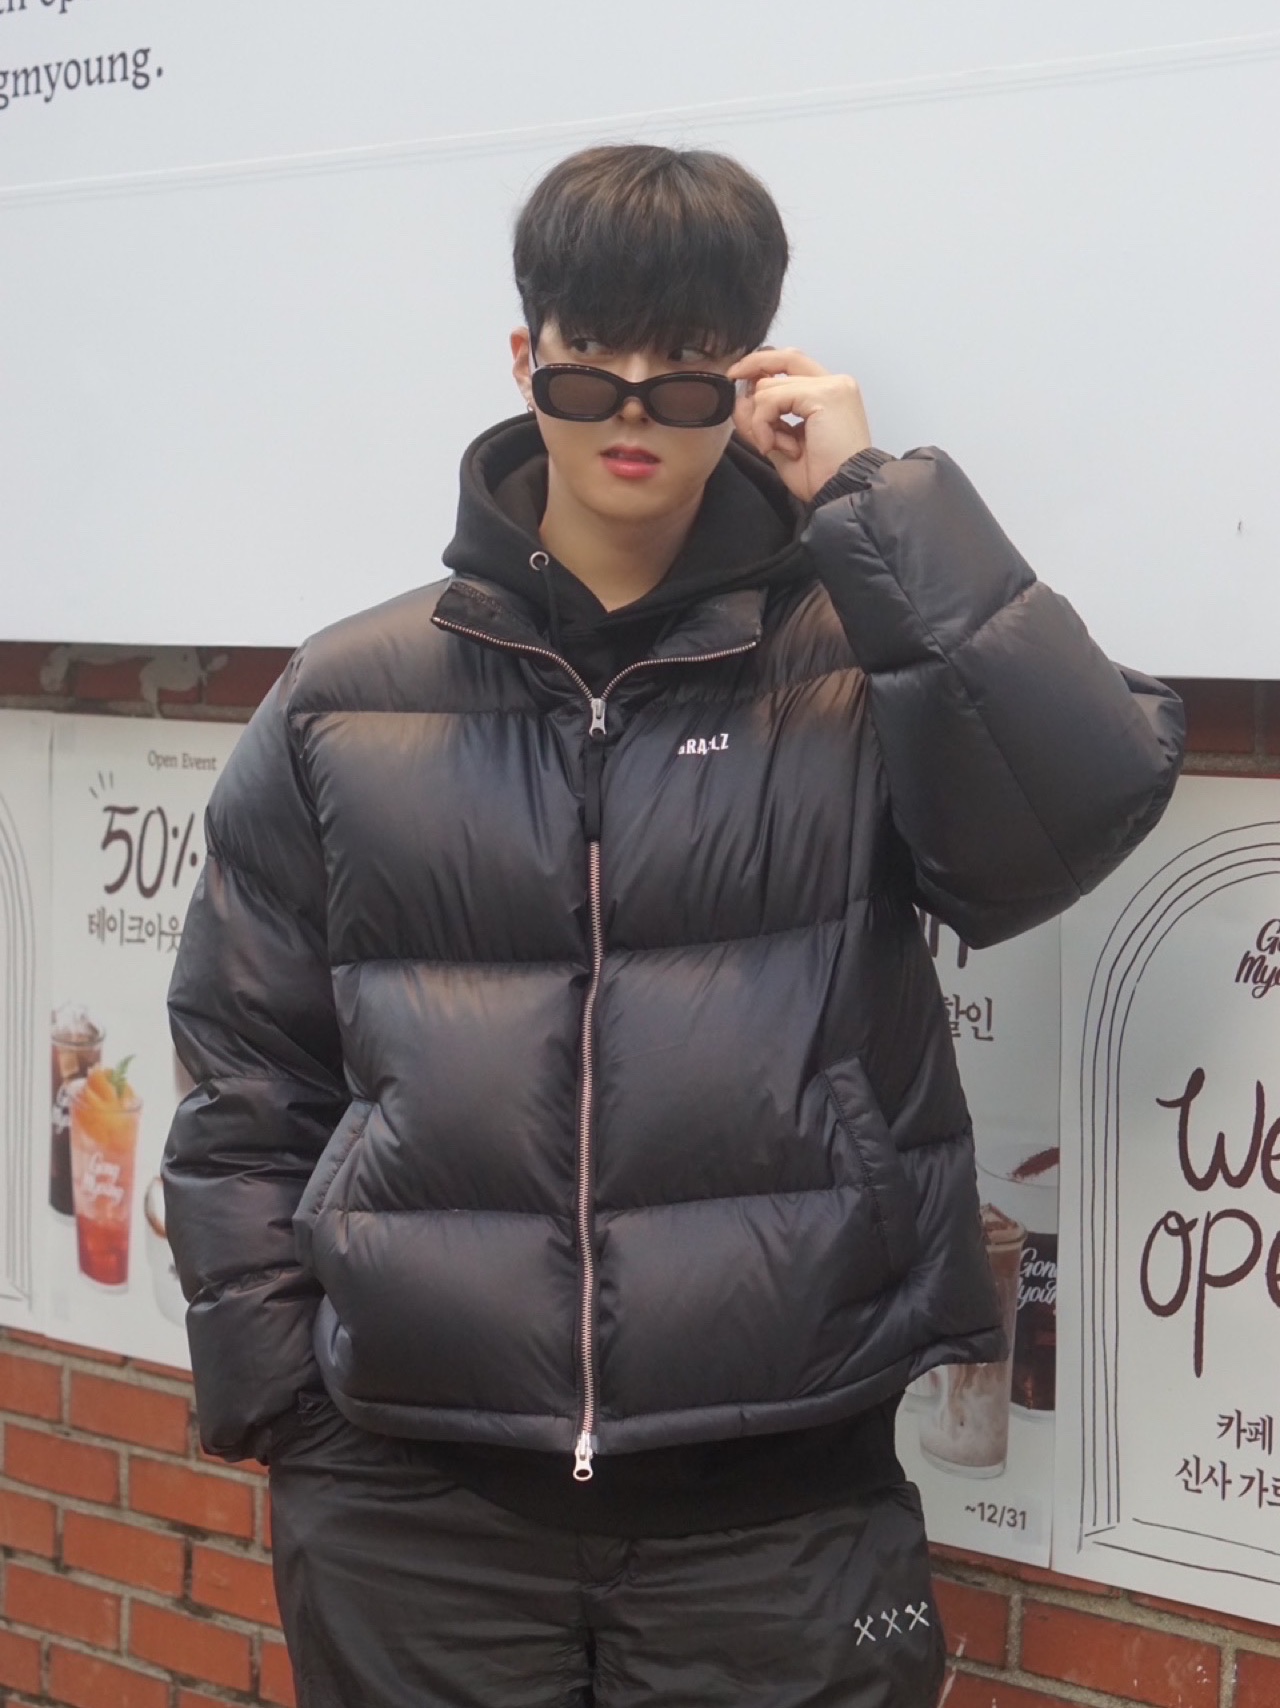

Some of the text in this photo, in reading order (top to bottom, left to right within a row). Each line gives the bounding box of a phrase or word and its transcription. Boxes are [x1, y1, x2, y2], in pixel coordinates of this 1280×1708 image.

[147, 749, 217, 771] Open Event
[101, 805, 198, 899] 50%
[88, 906, 183, 953] 테이크아웃
[1216, 1408, 1274, 1456] 카페
[1175, 1454, 1232, 1501] 신사
[965, 1502, 1027, 1531] ~12/31
